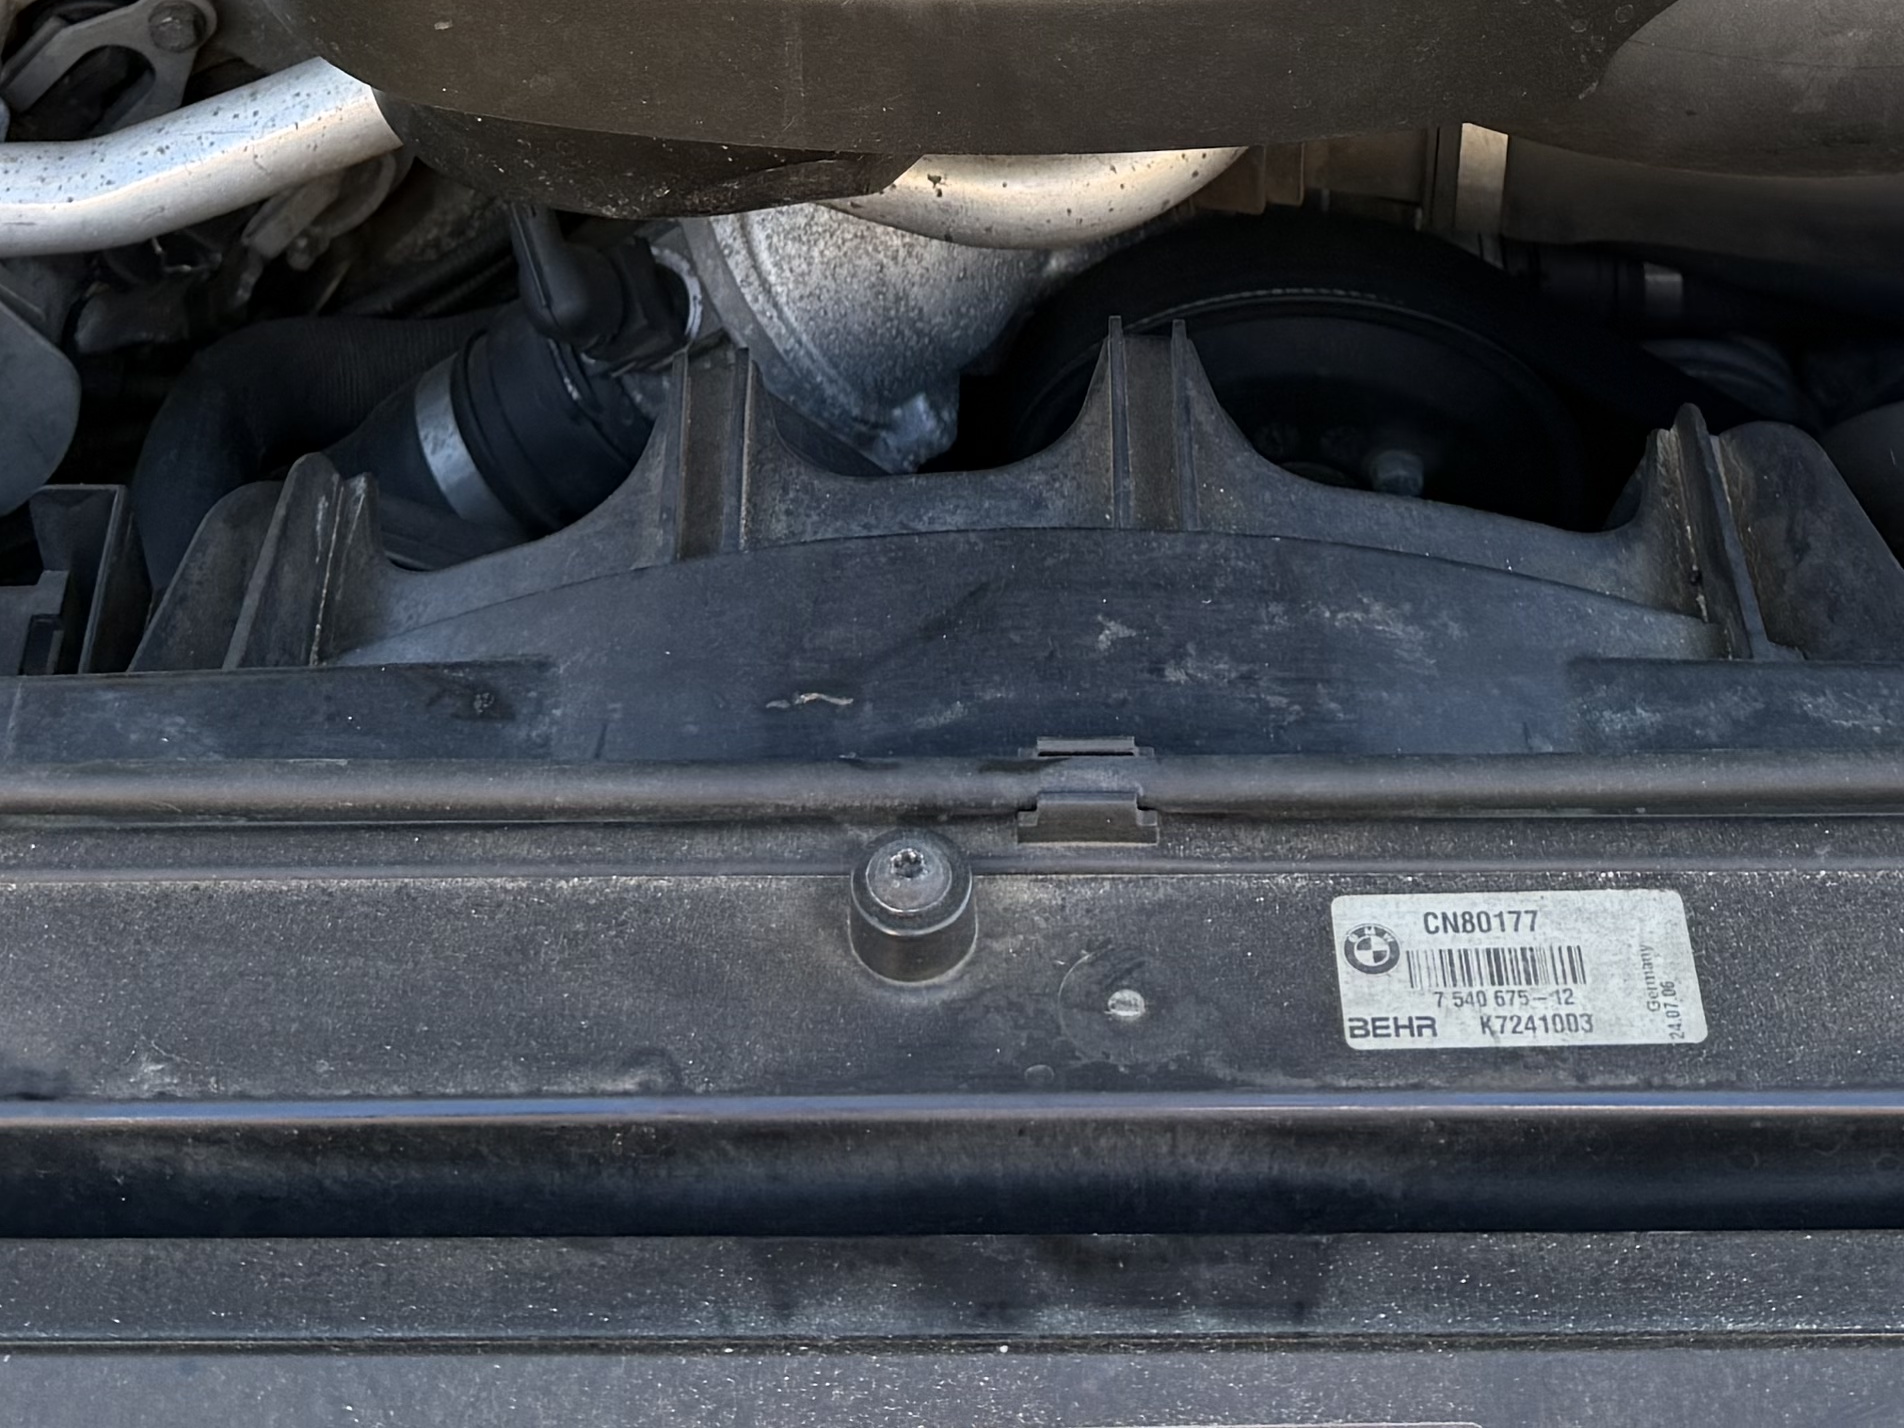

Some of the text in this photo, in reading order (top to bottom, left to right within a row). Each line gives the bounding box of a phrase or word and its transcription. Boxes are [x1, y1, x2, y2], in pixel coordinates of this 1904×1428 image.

[1423, 910, 1539, 935] CN80177
[1642, 943, 1663, 1013] Germany
[1436, 992, 1444, 1008] 7
[1454, 991, 1488, 1008] 540
[1659, 980, 1686, 1041] 24.07.06
[1348, 1016, 1438, 1039] BEHR
